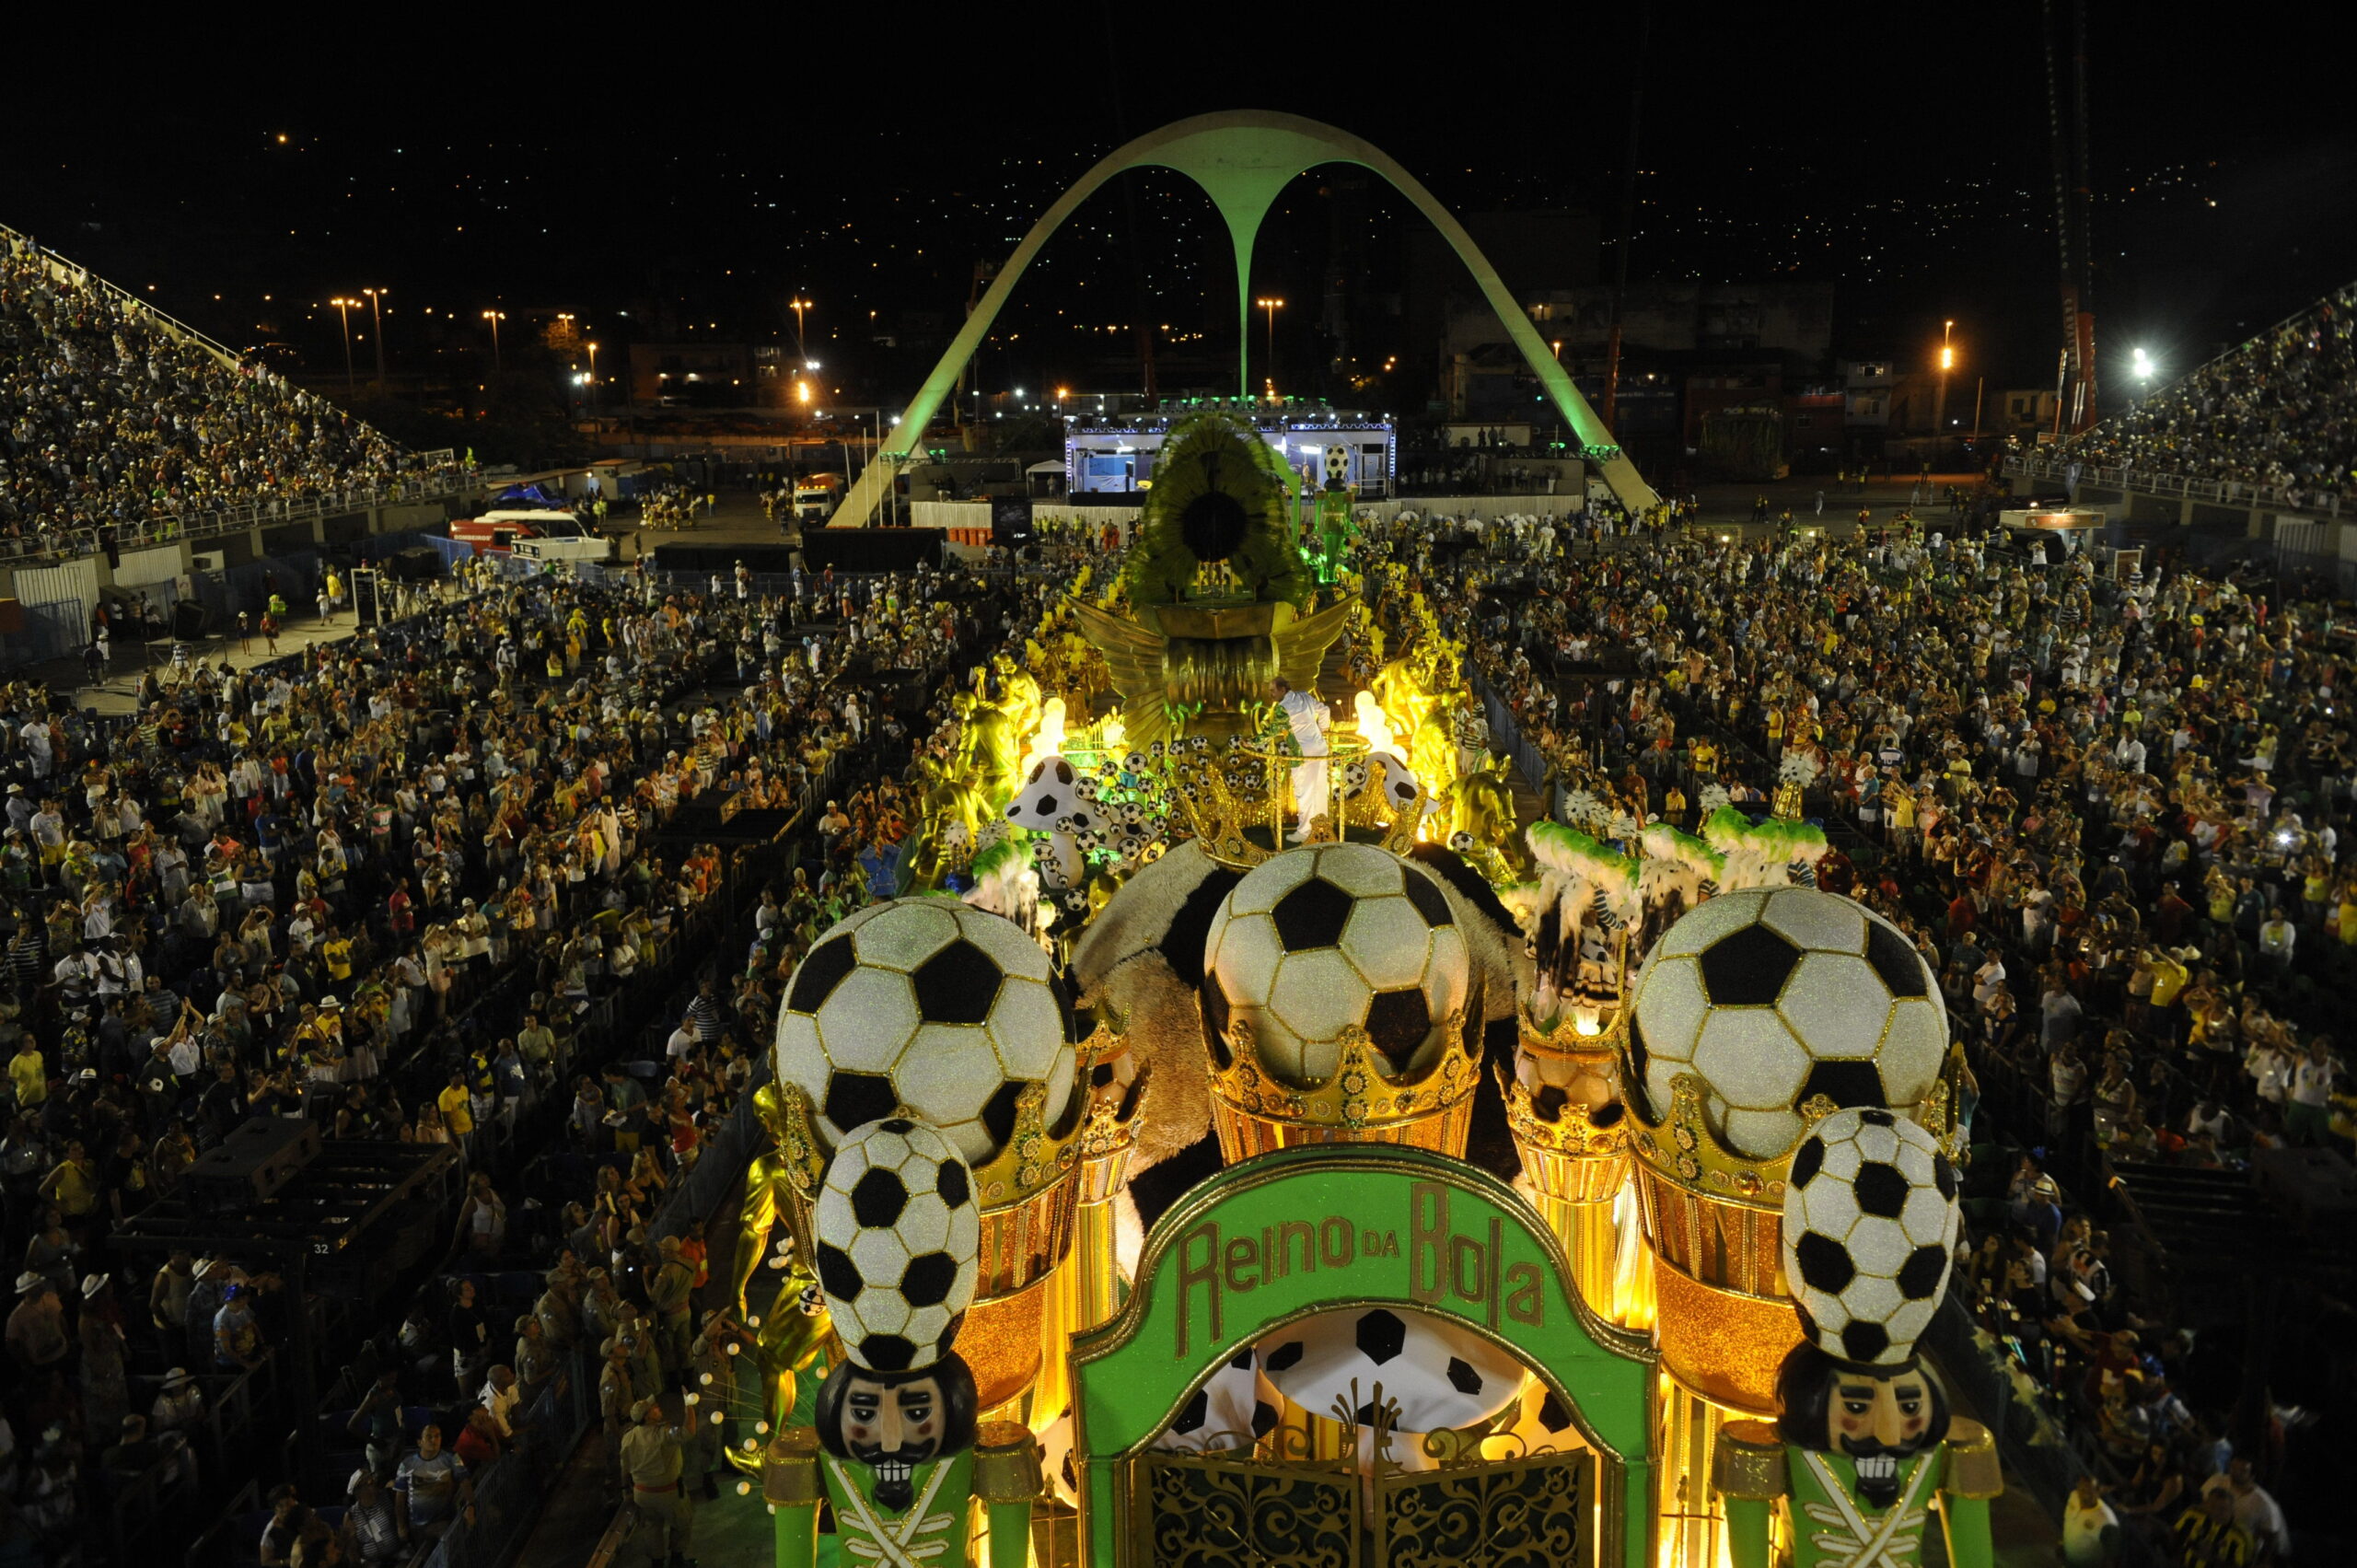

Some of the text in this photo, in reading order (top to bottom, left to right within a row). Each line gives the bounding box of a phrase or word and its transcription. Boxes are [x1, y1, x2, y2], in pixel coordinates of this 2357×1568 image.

[313, 1243, 330, 1254] 32
[1175, 1180, 1544, 1361] Reino DA Bola
